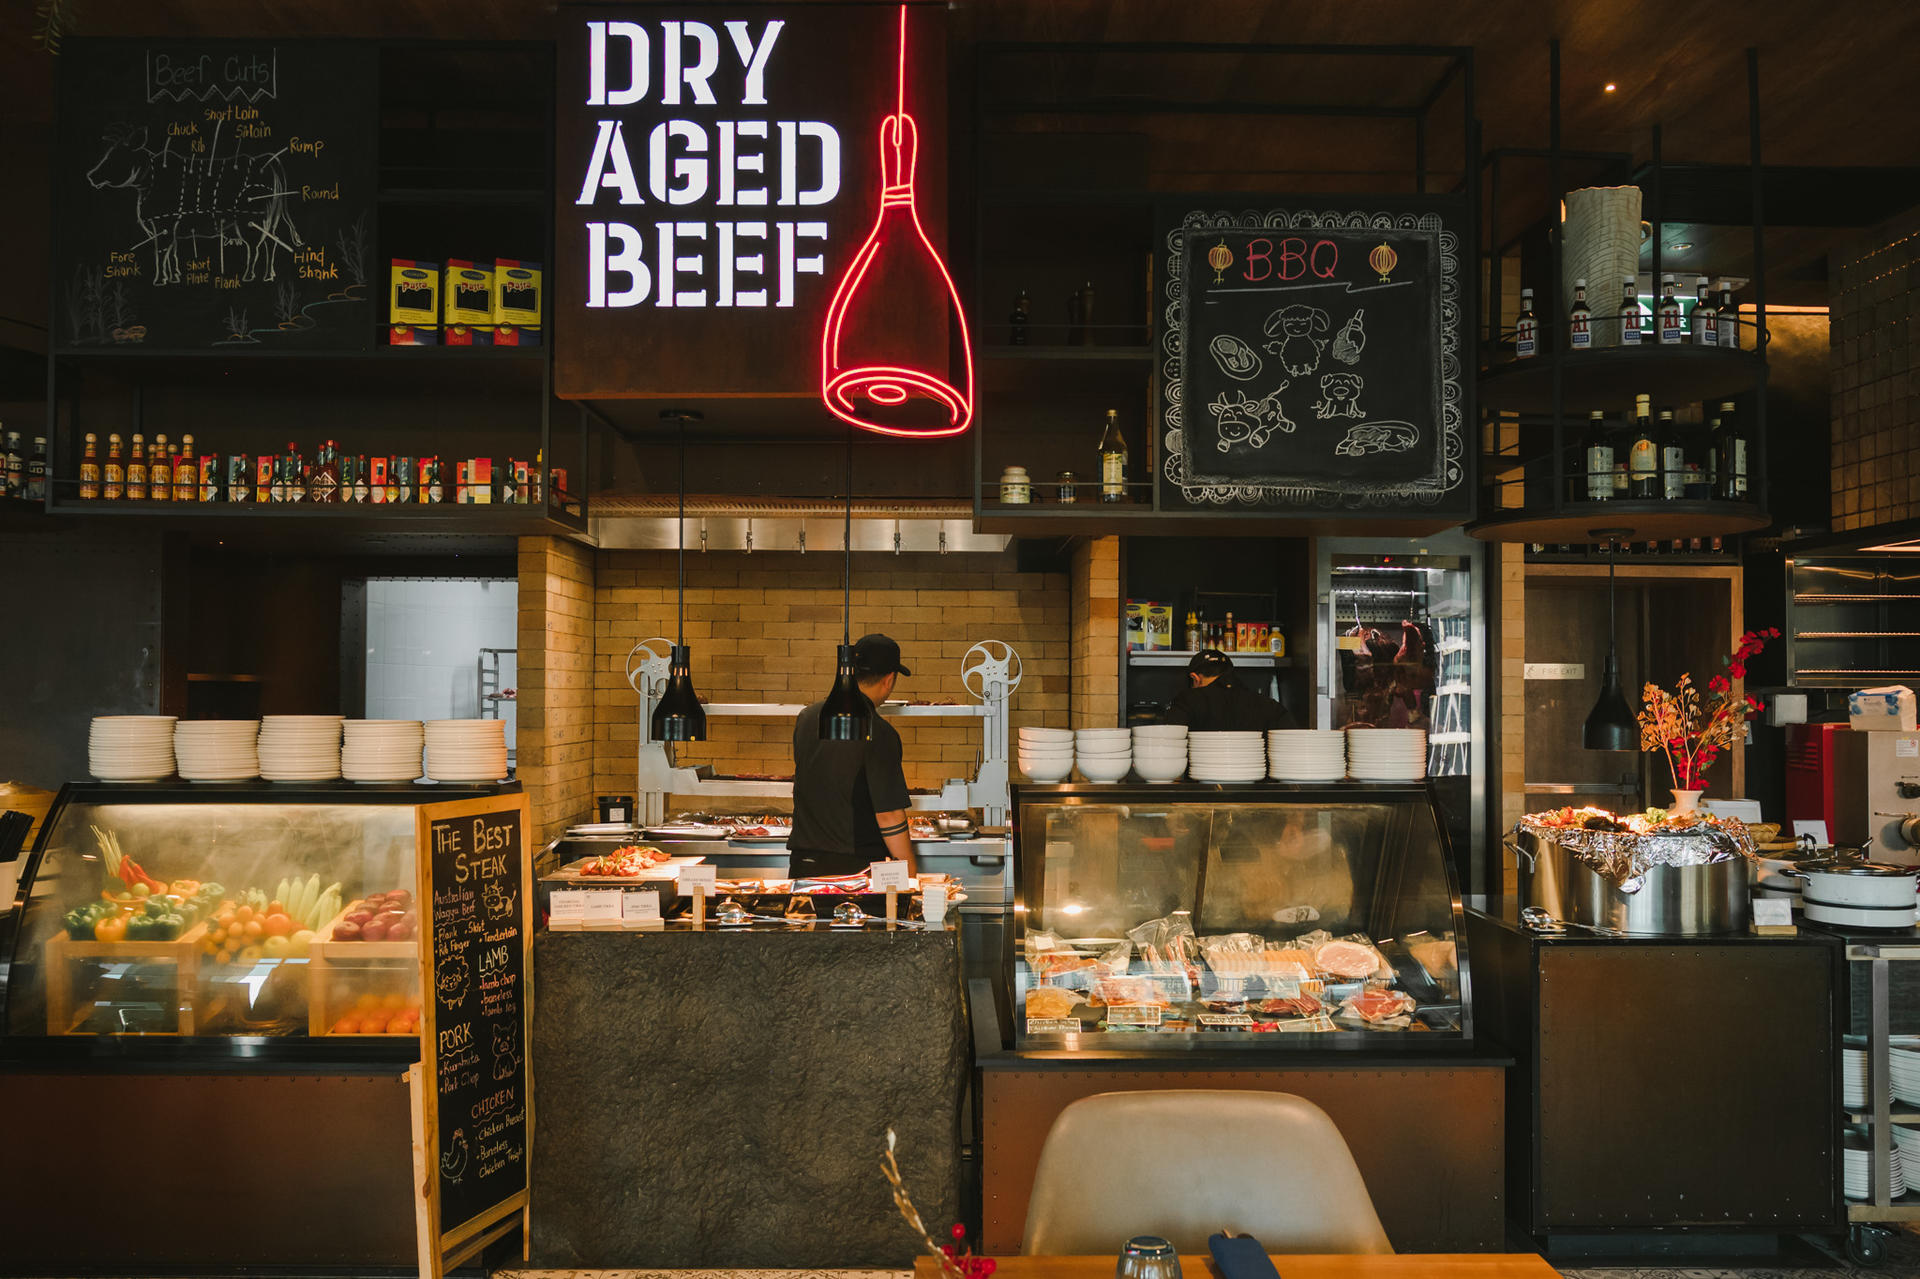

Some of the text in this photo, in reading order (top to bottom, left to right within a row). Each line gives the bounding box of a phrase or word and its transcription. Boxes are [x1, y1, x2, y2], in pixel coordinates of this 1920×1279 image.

[155, 54, 269, 86] Beef Cuts
[586, 21, 785, 105] DRY
[235, 104, 259, 120] Loin
[168, 120, 199, 136] Chuck
[191, 136, 206, 153] Rib
[289, 136, 325, 159] Rump
[576, 120, 840, 205] AGED
[302, 182, 339, 201] Round
[110, 251, 136, 264] Fore
[586, 222, 827, 307] BEEF
[1243, 238, 1338, 281] BBQ
[215, 272, 241, 289] Flank
[298, 262, 339, 280] Shank
[432, 818, 513, 854] THE BEST
[456, 853, 507, 883] STEAK
[483, 926, 518, 942] Tenderloin
[479, 945, 509, 972] LAMB
[440, 1022, 474, 1054] PORK
[471, 1085, 514, 1119] CHICKEN
[479, 1122, 504, 1141] Chicken
